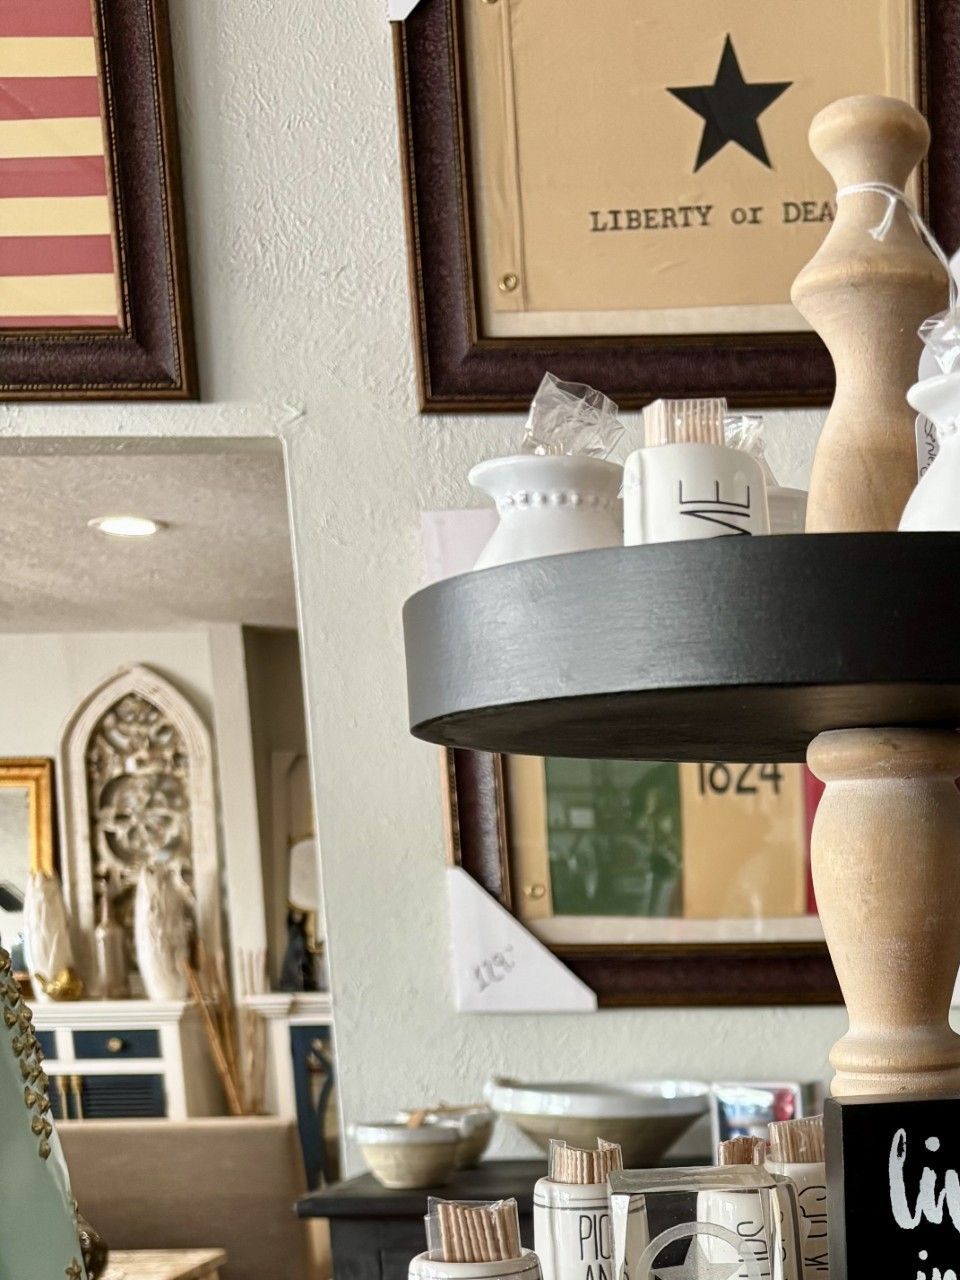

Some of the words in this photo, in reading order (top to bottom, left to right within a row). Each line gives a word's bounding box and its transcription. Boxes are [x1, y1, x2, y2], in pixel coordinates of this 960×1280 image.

[589, 204, 714, 232] LIBERTY
[730, 206, 764, 225] or
[783, 201, 838, 223] DEA
[579, 1213, 628, 1267] PIC
